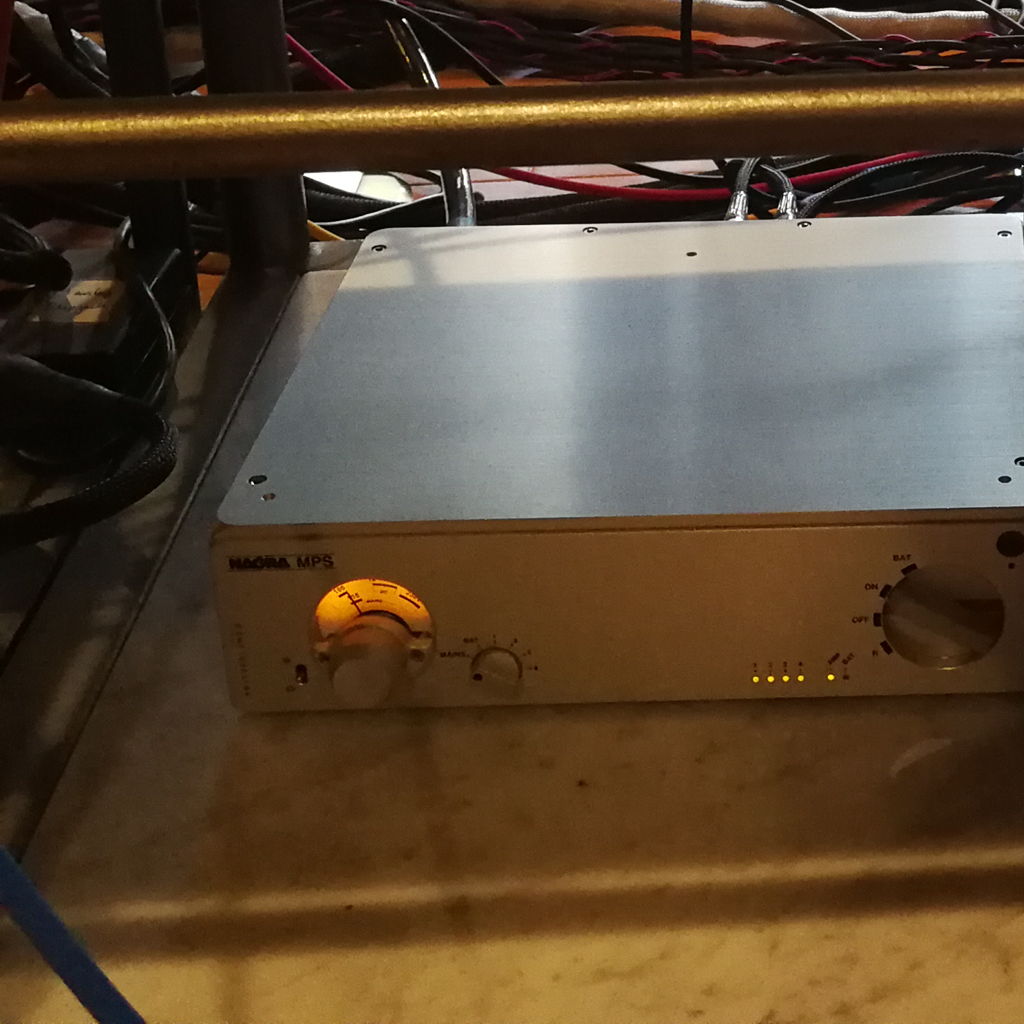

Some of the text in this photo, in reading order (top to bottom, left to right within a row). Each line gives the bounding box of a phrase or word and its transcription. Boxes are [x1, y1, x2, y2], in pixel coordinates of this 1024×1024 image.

[228, 554, 334, 569] NAGRA MPS
[864, 583, 879, 591] ON
